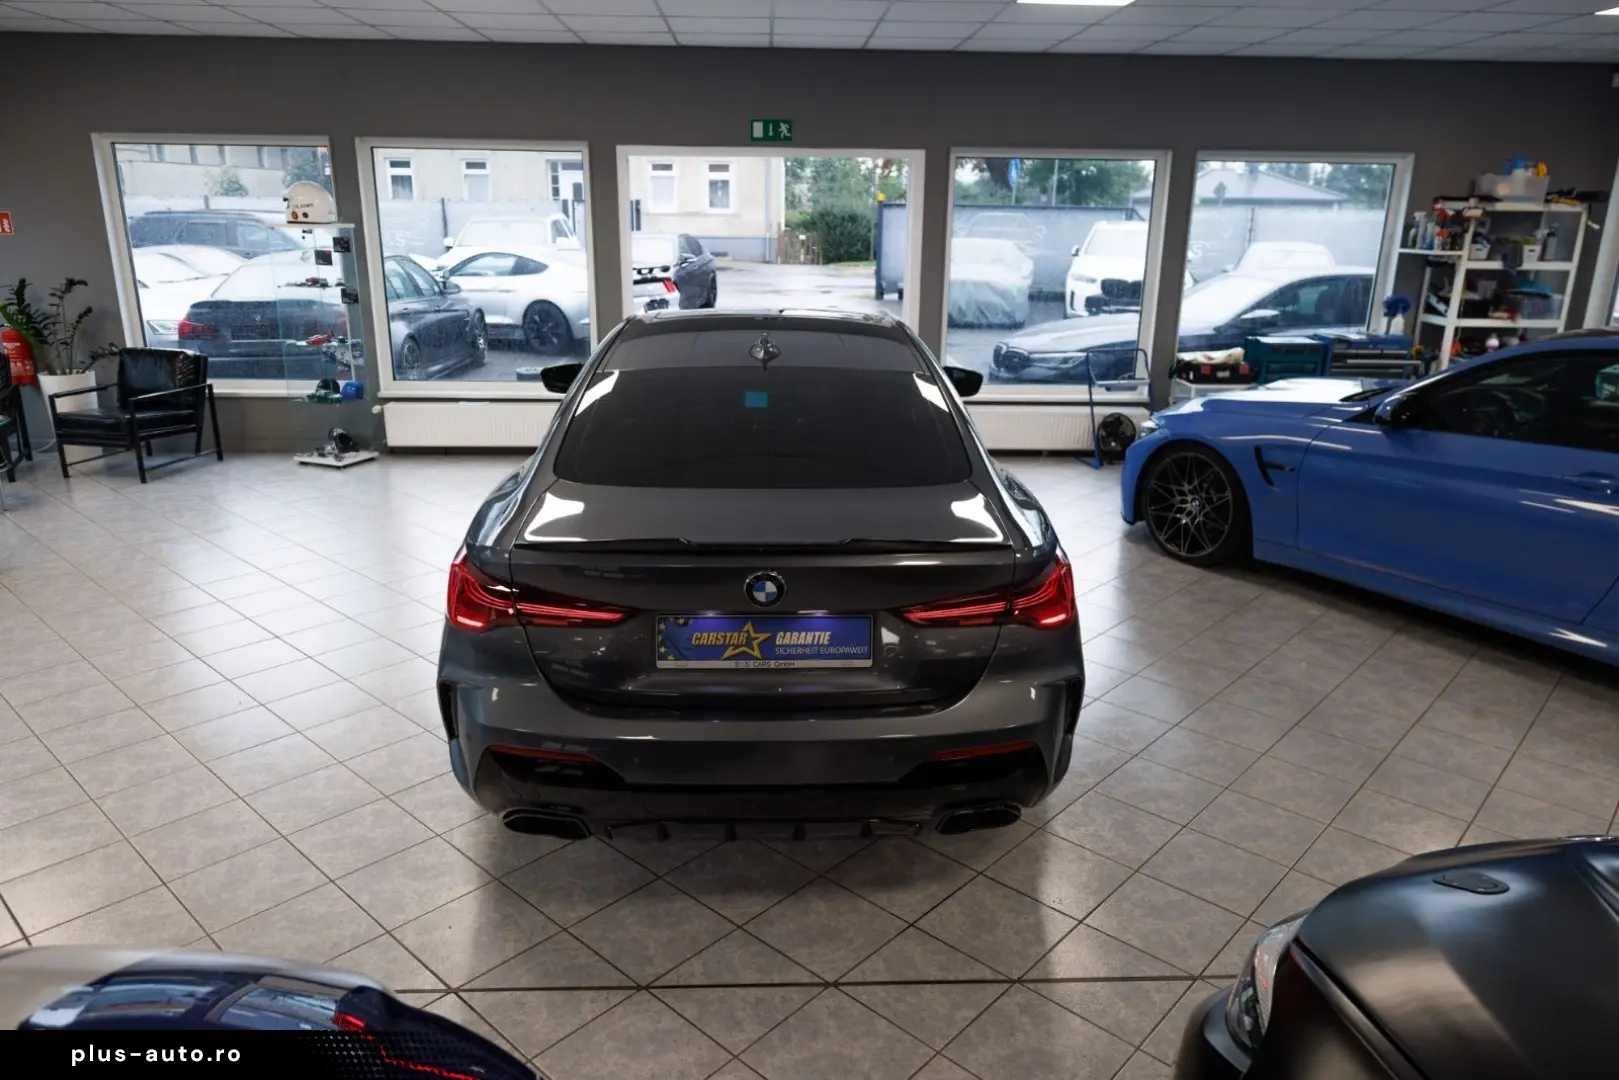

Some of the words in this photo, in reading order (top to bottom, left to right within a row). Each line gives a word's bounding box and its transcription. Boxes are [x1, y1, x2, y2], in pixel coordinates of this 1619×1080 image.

[691, 631, 748, 645] CARSTAR
[775, 631, 832, 645] GARANTIE
[775, 646, 818, 655] SICHERHEIT
